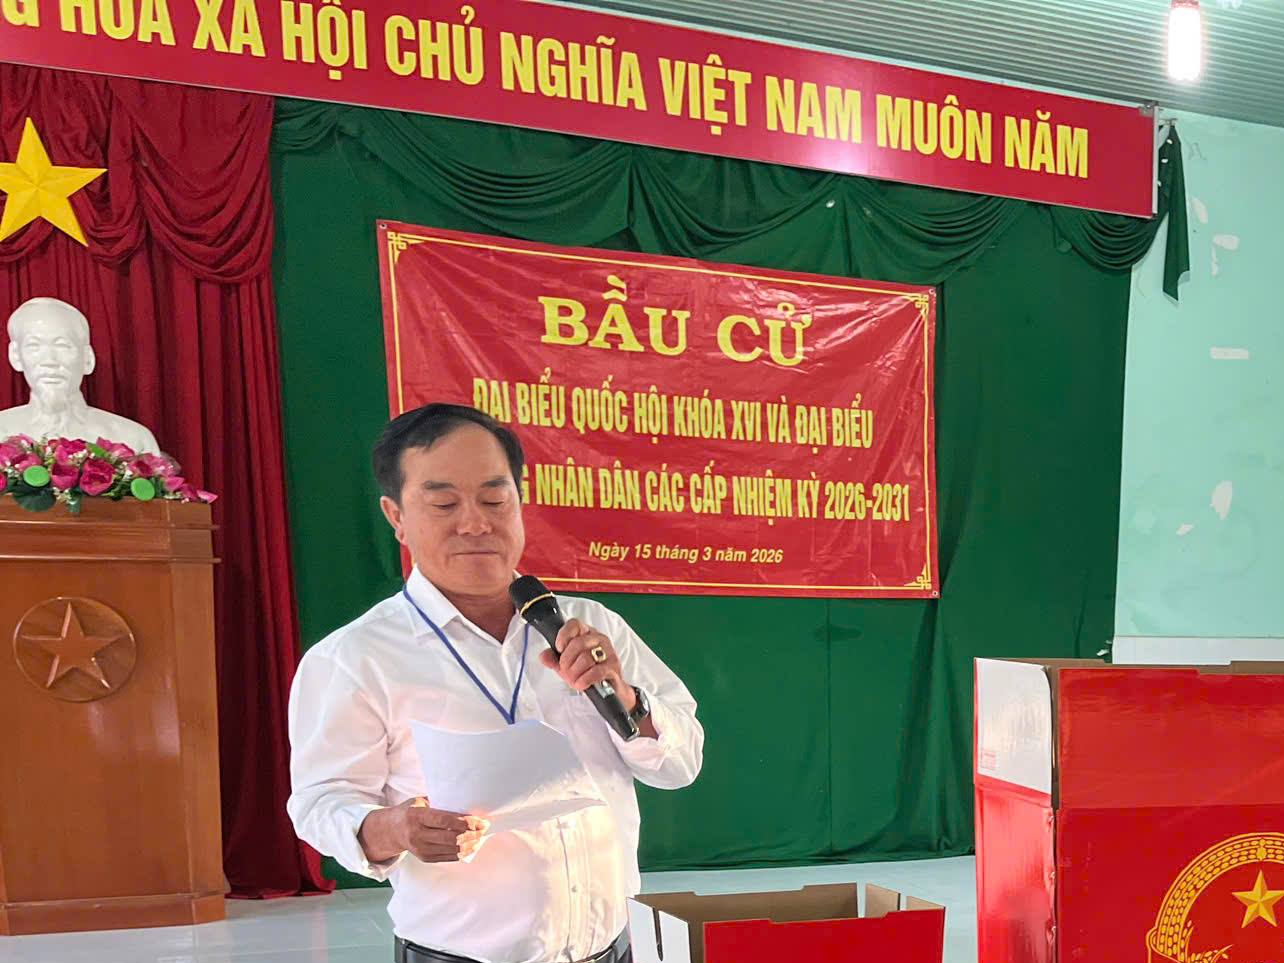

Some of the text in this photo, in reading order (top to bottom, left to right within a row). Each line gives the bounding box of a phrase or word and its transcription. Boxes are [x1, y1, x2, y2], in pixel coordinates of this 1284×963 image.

[280, 0, 368, 81] HỘI
[384, 5, 484, 85] CHỦ
[500, 35, 647, 112] NGHĨA
[658, 55, 752, 136] VIỆT
[766, 76, 862, 144] NAM
[876, 94, 992, 164] MUÔN
[1003, 110, 1089, 178] NĂM
[538, 274, 813, 367] BẦU CỬ
[515, 366, 566, 428] BIỂU
[571, 374, 628, 434] QUỐC
[633, 384, 669, 444] HỘI
[673, 389, 727, 440] KHÓA
[730, 400, 762, 442] XVI
[766, 394, 792, 444] VÀ
[794, 404, 827, 454] ĐẠI
[831, 392, 874, 449] BIỂU
[535, 456, 594, 508] NHÂN
[598, 459, 641, 511] DÂN
[645, 463, 685, 513] CÁC
[689, 460, 728, 515] CẤP
[732, 468, 793, 526] NHIỆM
[797, 471, 821, 518] KỲ
[824, 480, 910, 522] 2026-2031
[588, 541, 784, 564] Ngày 15 tháng 3 năm 2026
